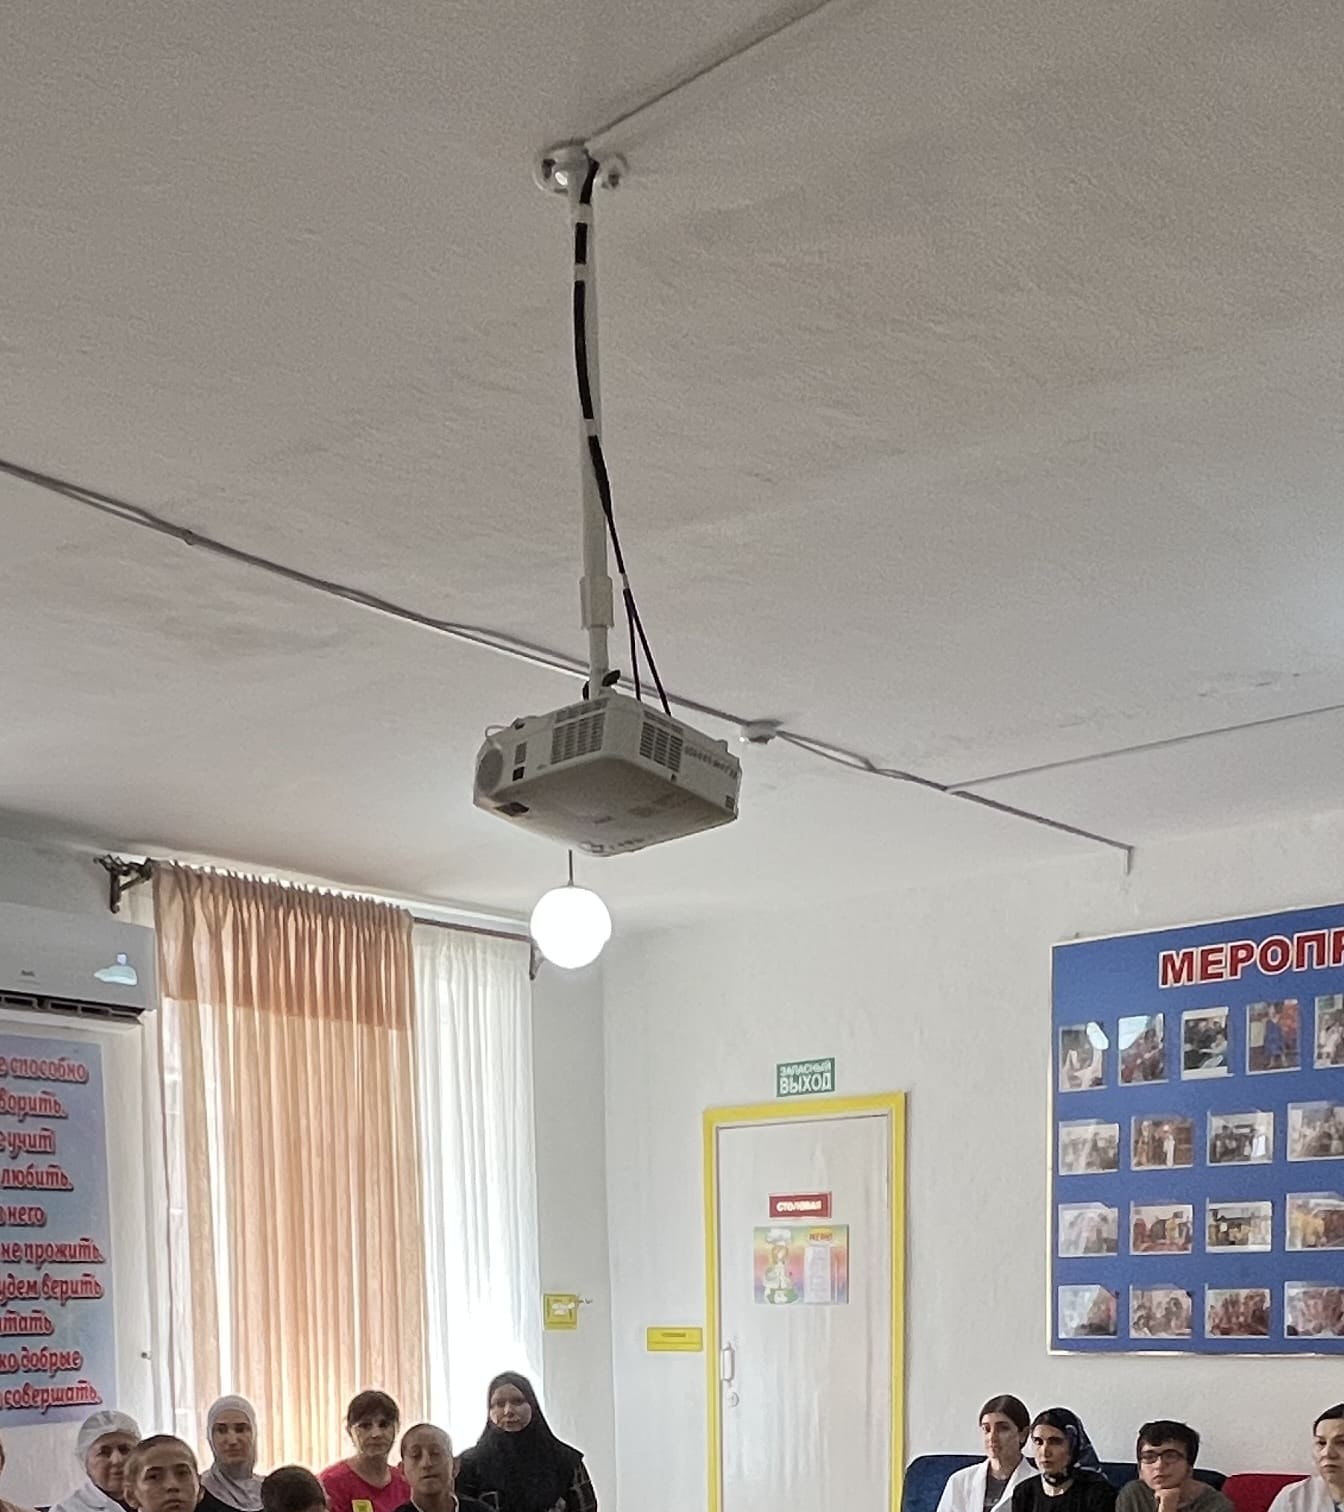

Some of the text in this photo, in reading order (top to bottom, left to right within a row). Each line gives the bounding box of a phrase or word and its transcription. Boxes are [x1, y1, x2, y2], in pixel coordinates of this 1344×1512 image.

[10, 1056, 88, 1081] способно
[779, 1060, 831, 1077] ЗАПАСНЫЙ
[779, 1072, 832, 1094] ВЫХОД
[6, 1127, 56, 1157] учит
[7, 1204, 47, 1226] него
[1, 1241, 21, 1262] не
[41, 1272, 104, 1305] верить
[20, 1345, 83, 1376] добрые
